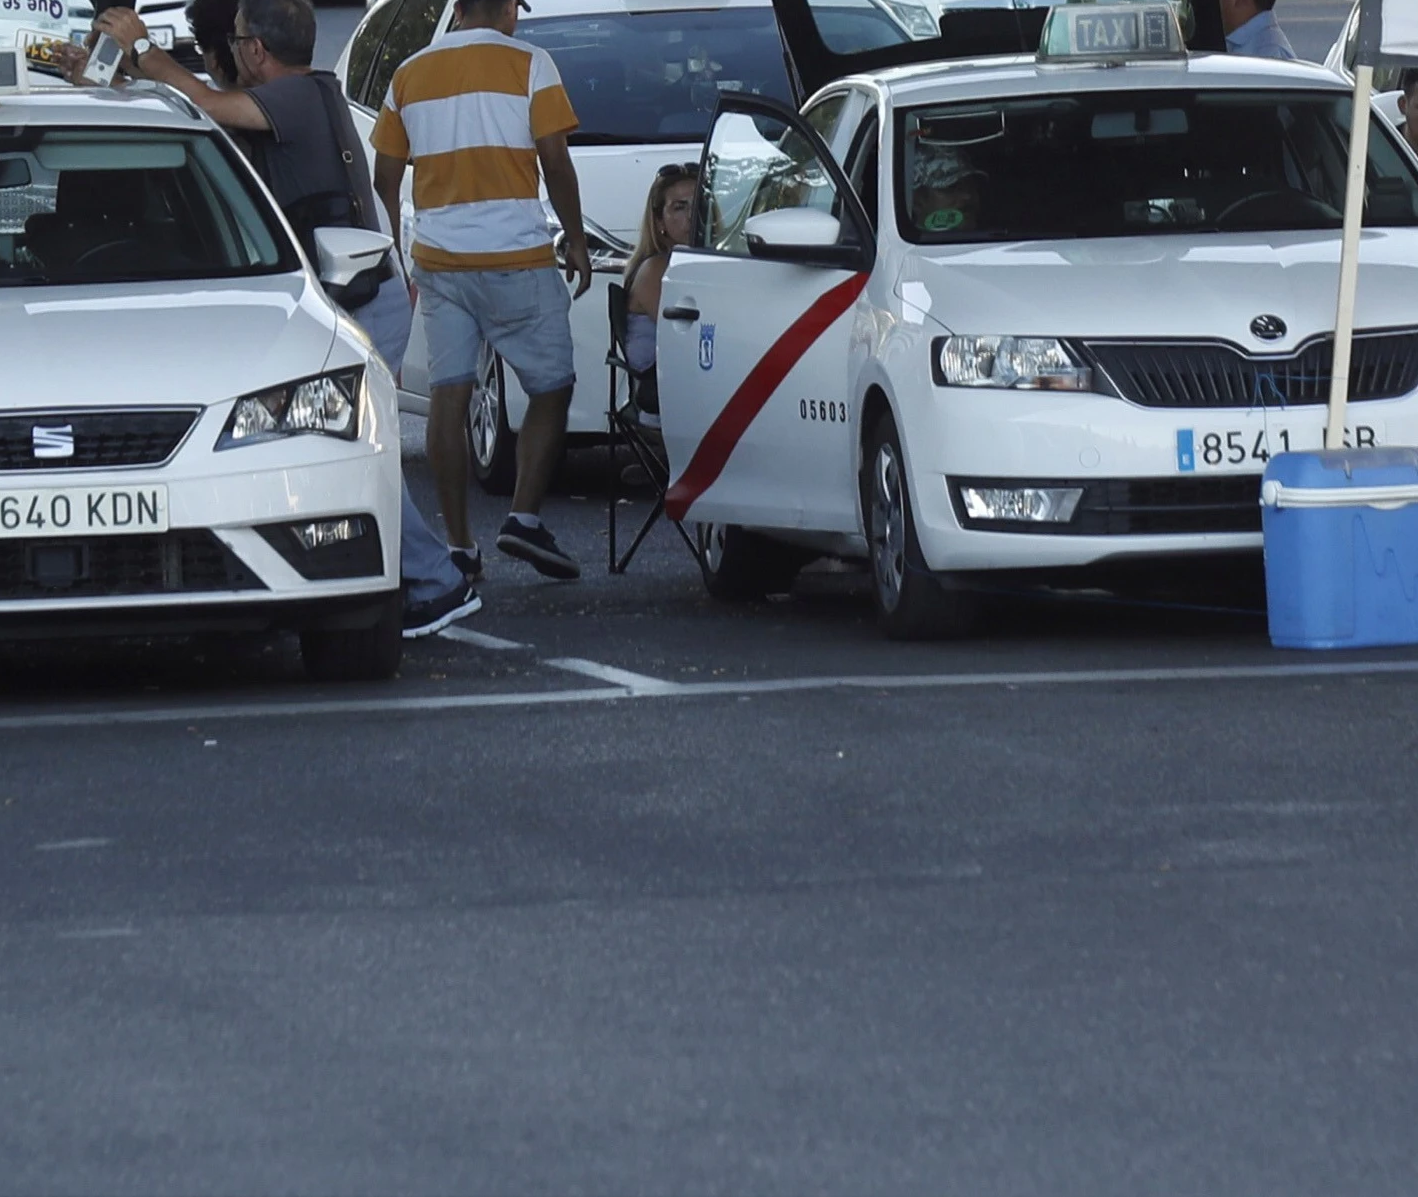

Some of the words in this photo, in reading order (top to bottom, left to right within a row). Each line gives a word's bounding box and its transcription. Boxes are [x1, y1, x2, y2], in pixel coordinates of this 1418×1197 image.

[1079, 15, 1133, 47] TAXI
[800, 399, 846, 422] 05603
[1202, 430, 1290, 465] 8541
[87, 491, 161, 527] KDN
